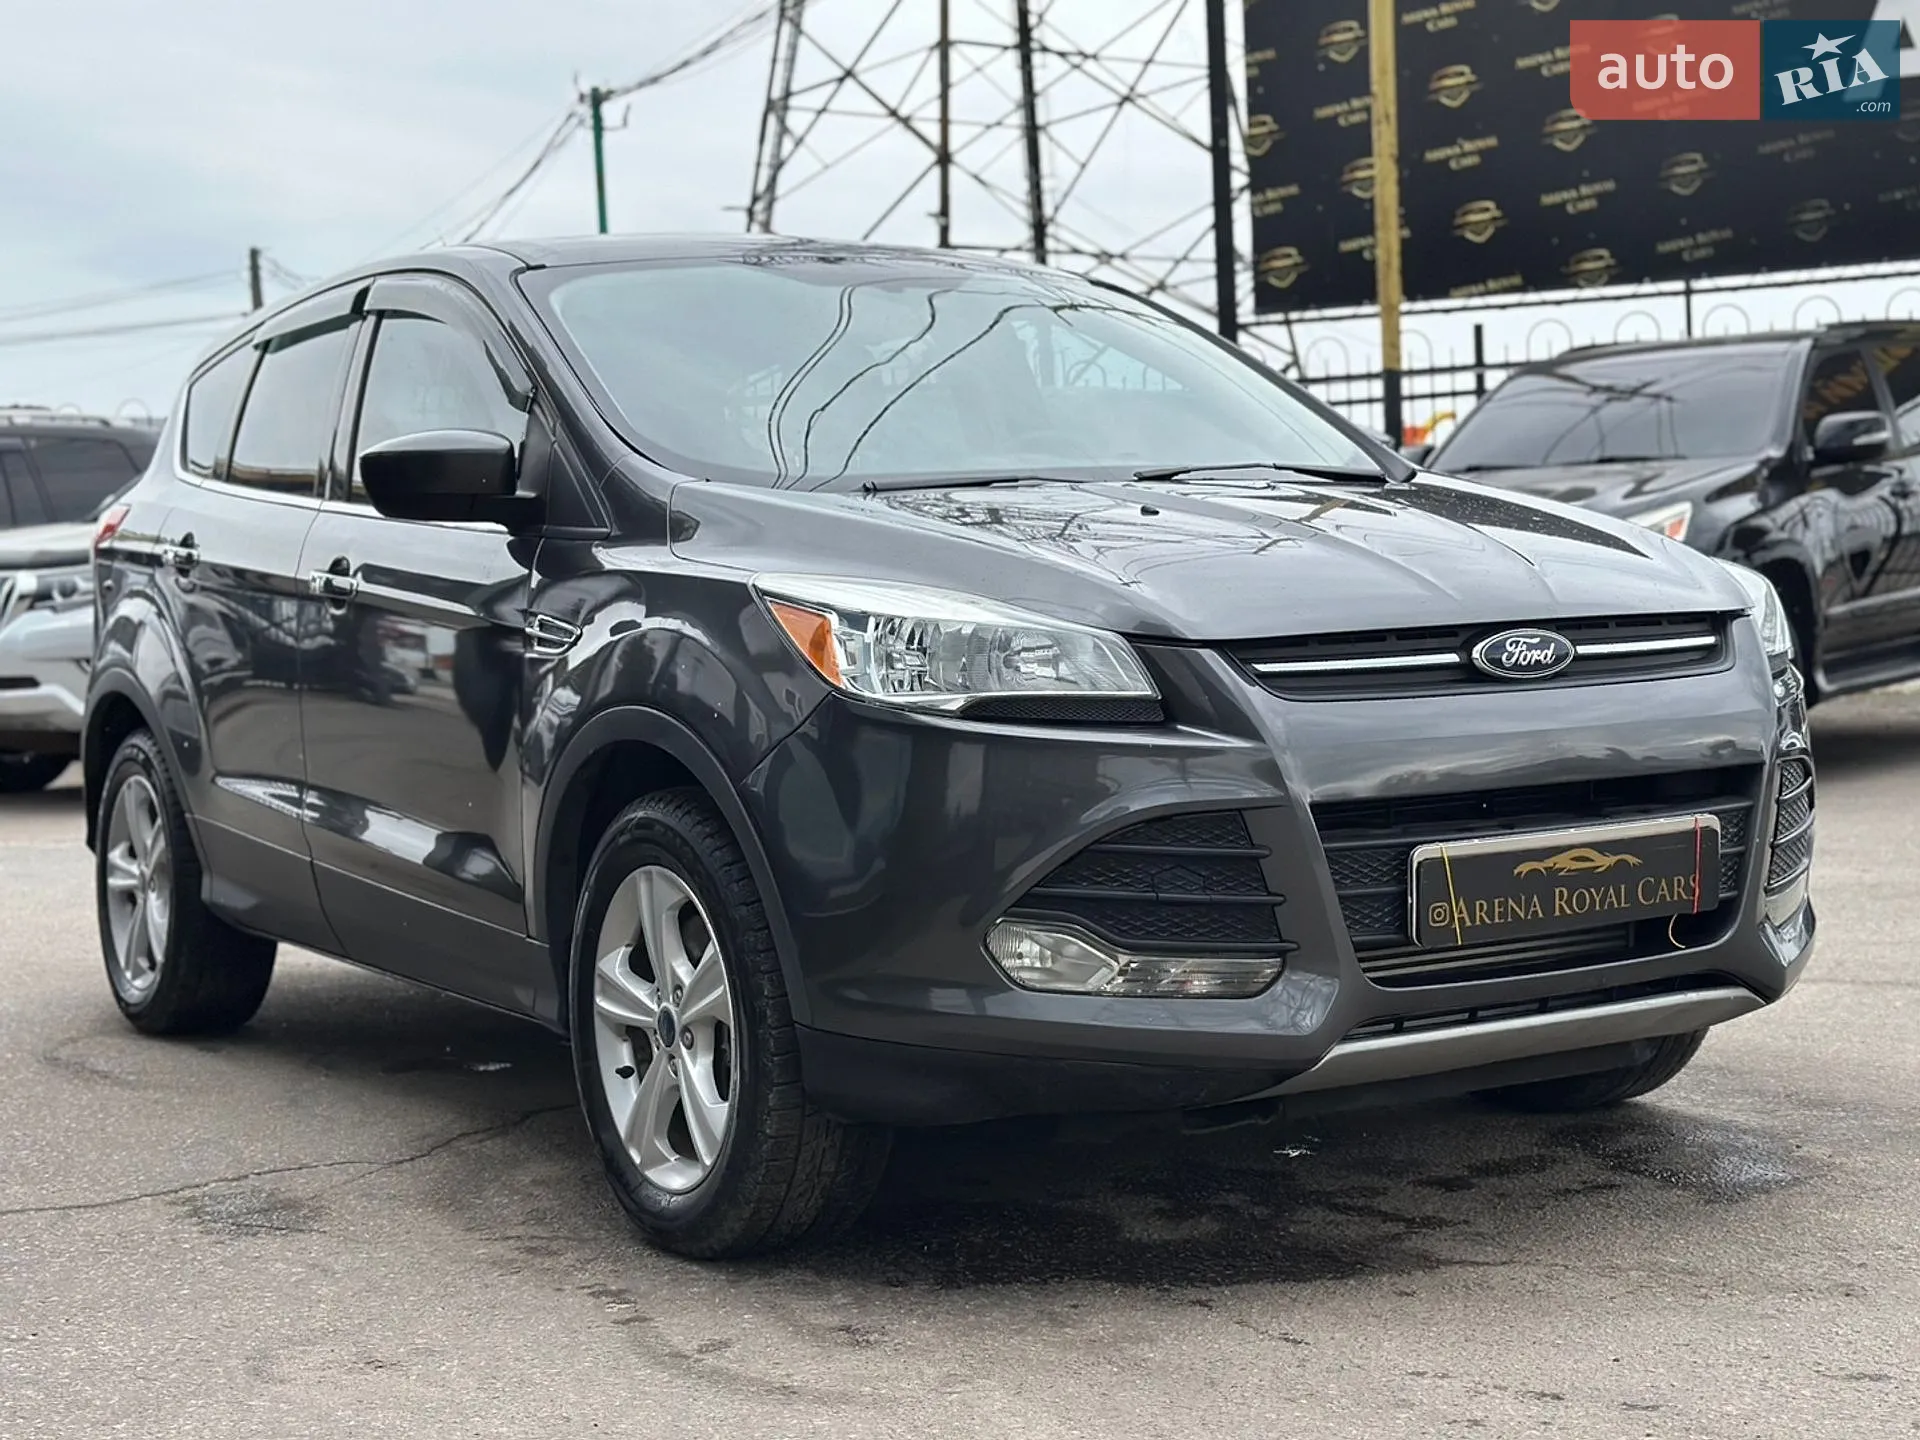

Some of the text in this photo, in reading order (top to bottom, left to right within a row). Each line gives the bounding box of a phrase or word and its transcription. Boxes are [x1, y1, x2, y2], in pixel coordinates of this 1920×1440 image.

[1501, 637, 1556, 667] Ford
[1451, 893, 1545, 928] ARENA
[1553, 884, 1631, 917] ROYAL
